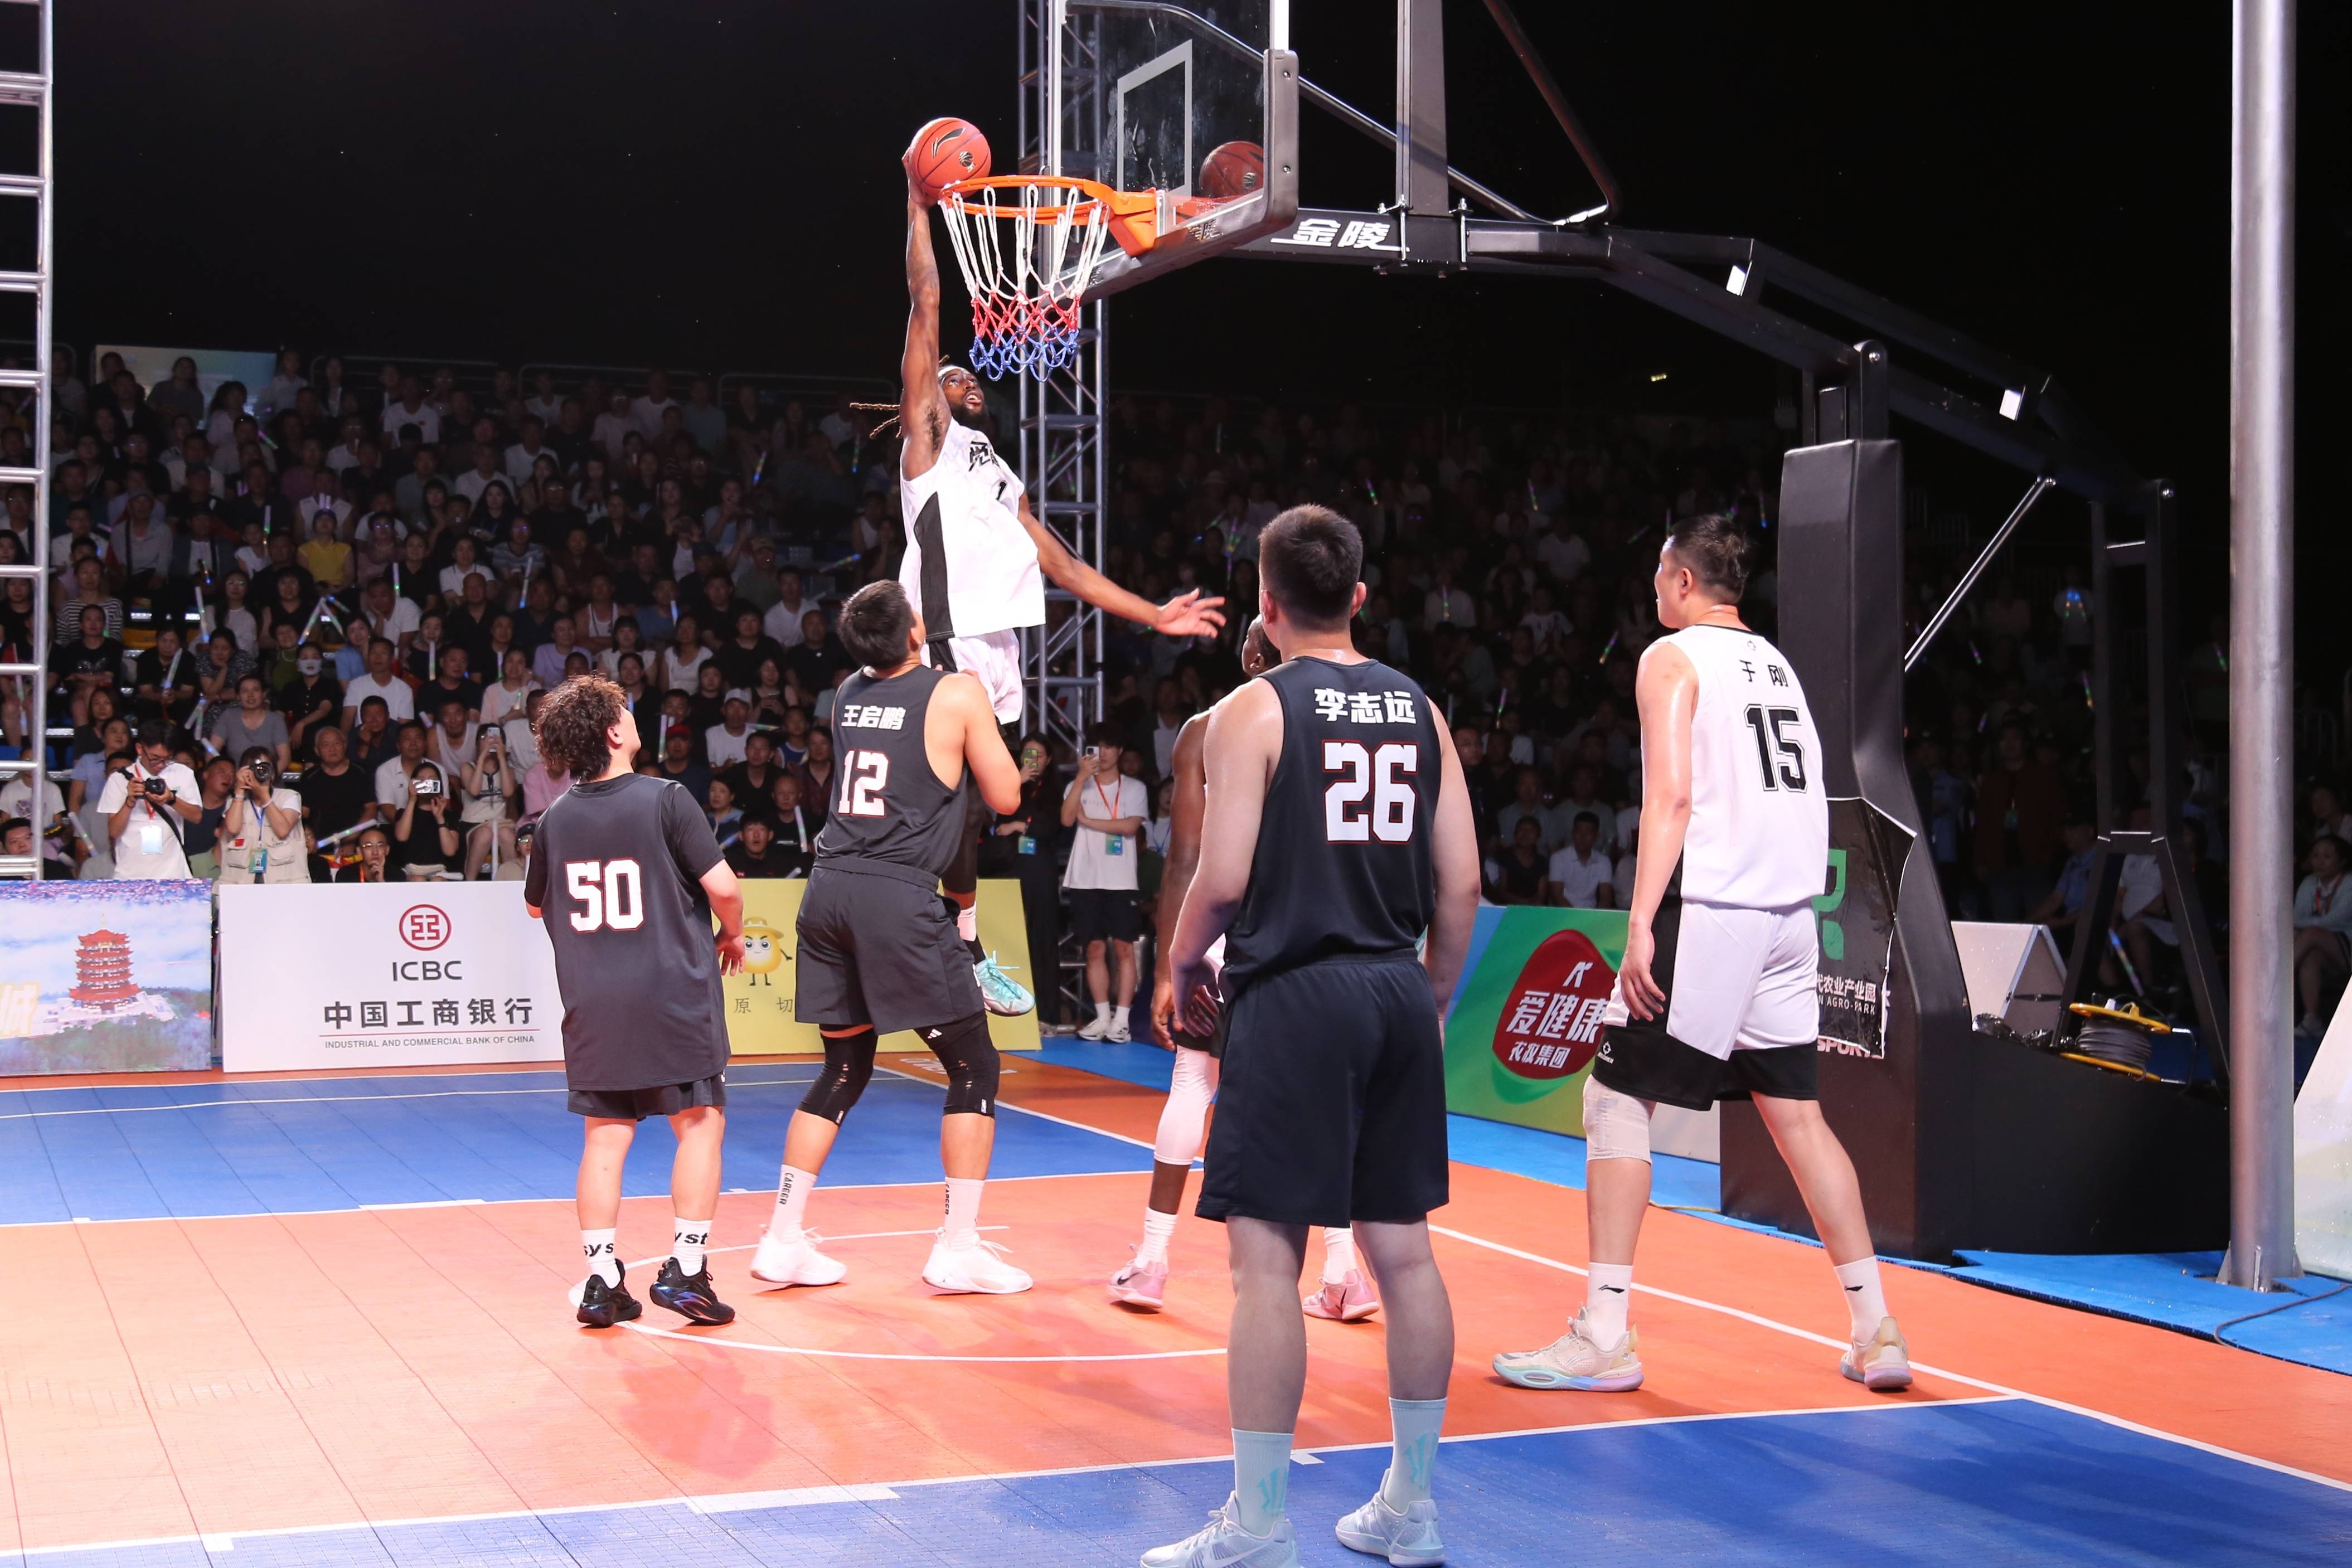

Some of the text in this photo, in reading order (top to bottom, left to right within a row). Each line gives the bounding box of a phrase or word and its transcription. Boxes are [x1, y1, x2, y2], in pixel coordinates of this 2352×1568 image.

[1287, 217, 1395, 249] 金陵
[841, 705, 906, 730] 王启鹏
[1314, 687, 1418, 724] 李志远
[1743, 704, 1808, 794] 15
[838, 750, 889, 817] 12
[1321, 740, 1419, 843] 26
[565, 857, 644, 933] 50
[392, 960, 463, 982] ICBC
[324, 997, 532, 1030] 中国工商银行
[1506, 990, 1610, 1043] 爱健康
[1826, 996, 1875, 1015] AGRO-PARK
[325, 1040, 379, 1048] INDUSTRIAL
[403, 1037, 463, 1046] COMMERCIAL
[507, 1035, 535, 1043] CHINA
[778, 1172, 794, 1205] CAREER
